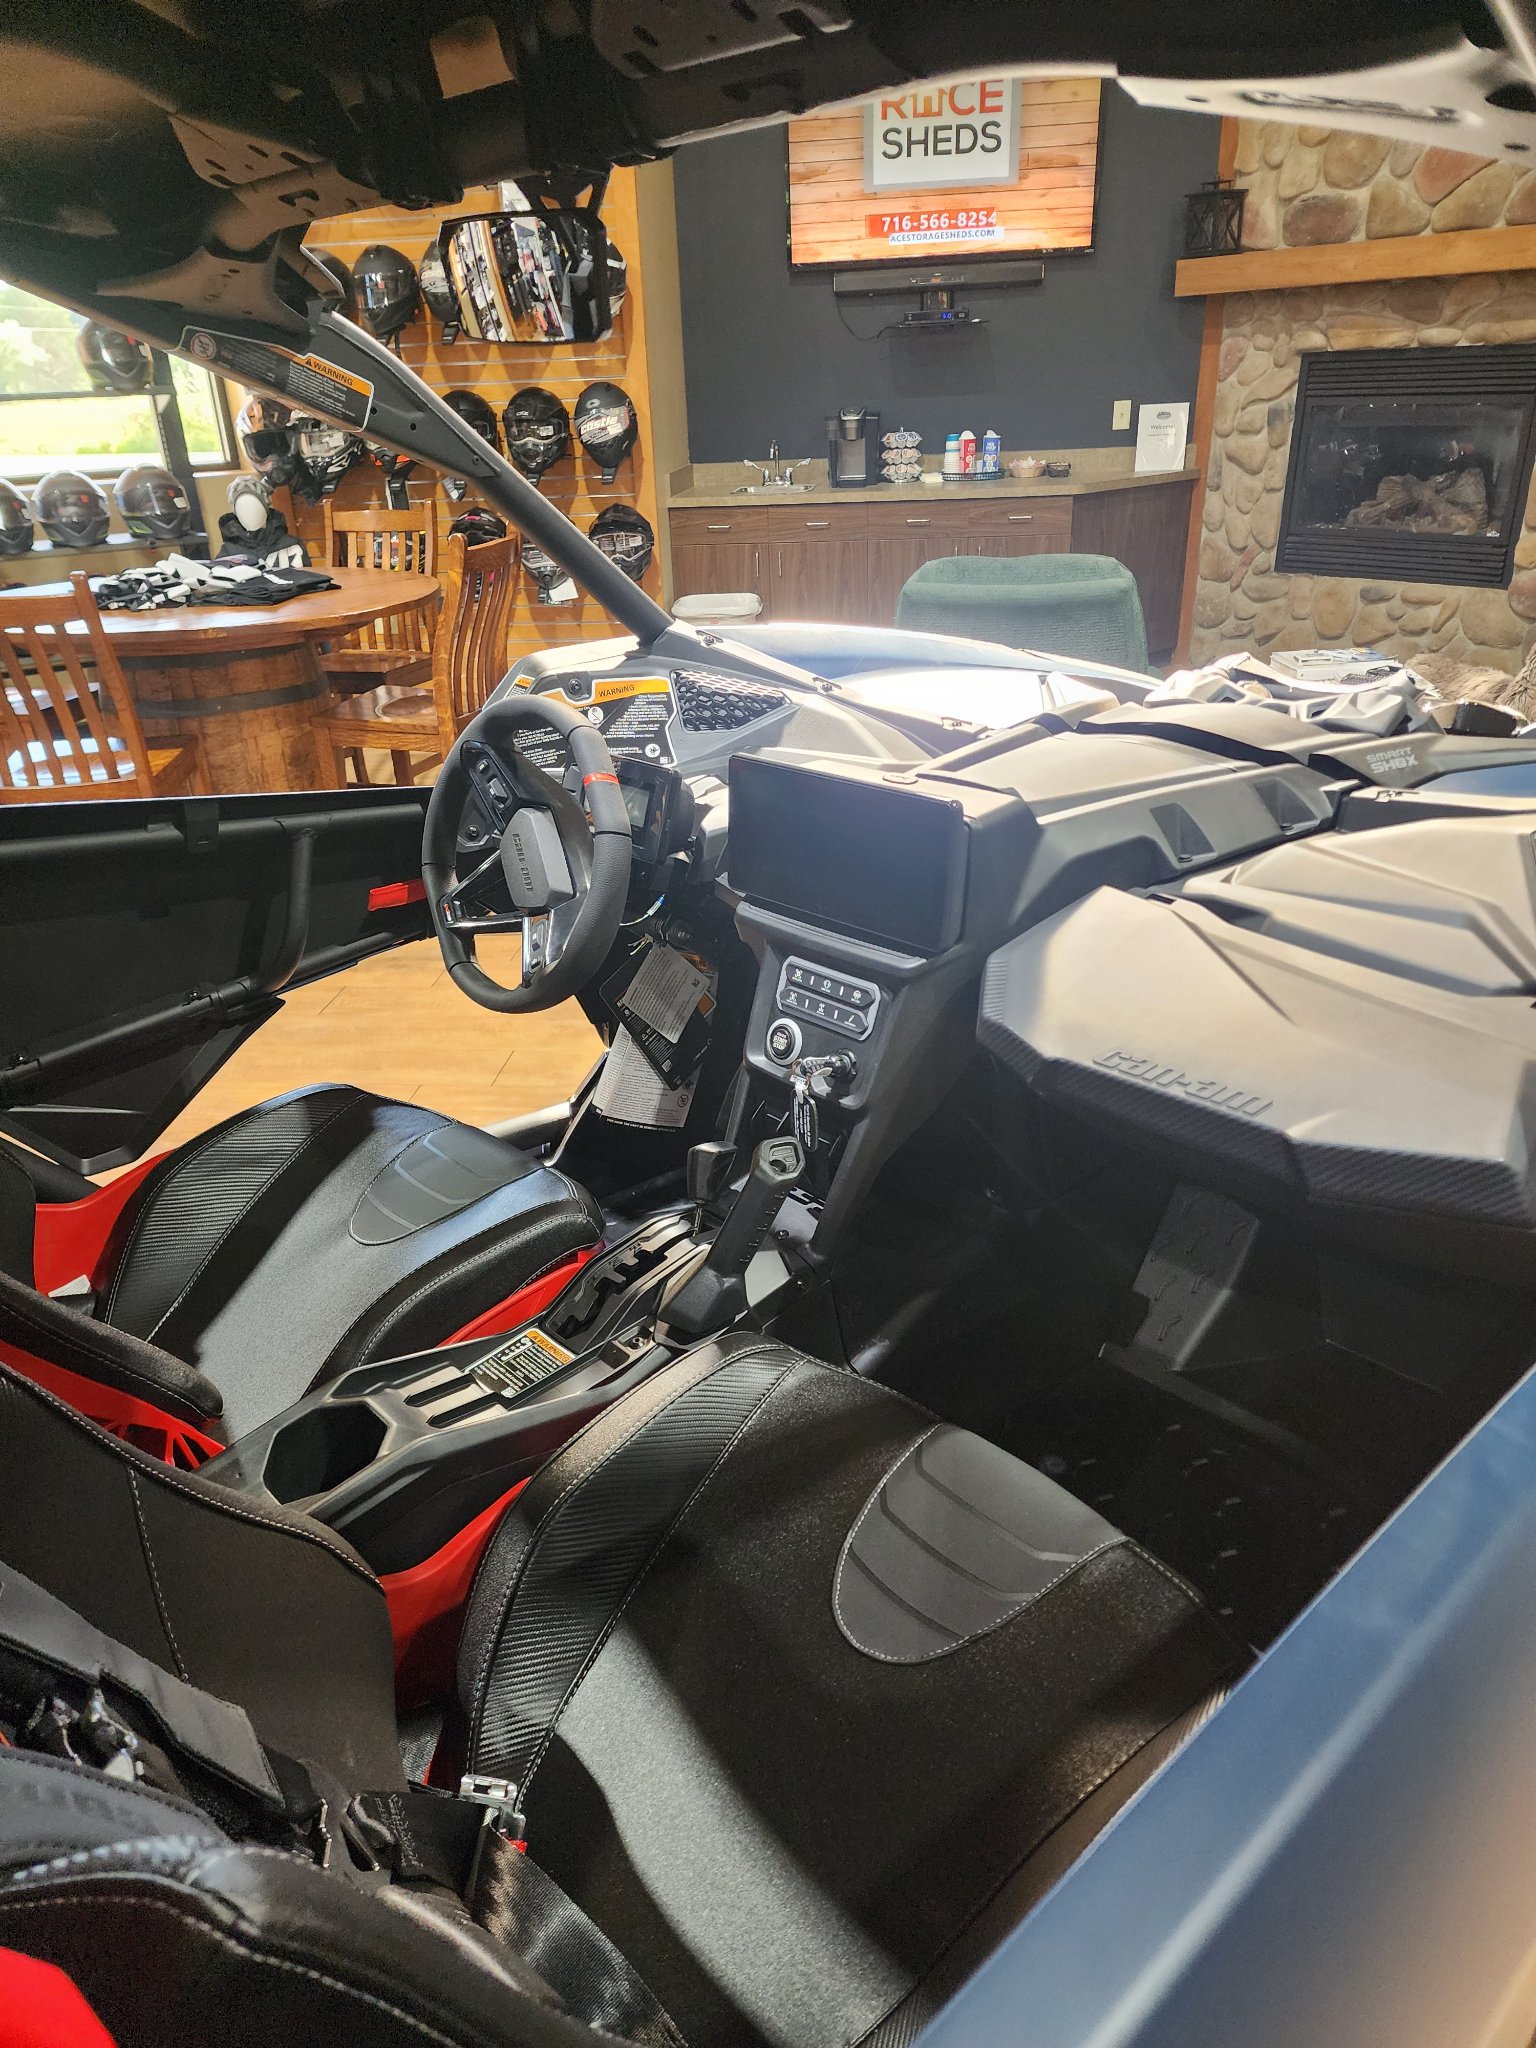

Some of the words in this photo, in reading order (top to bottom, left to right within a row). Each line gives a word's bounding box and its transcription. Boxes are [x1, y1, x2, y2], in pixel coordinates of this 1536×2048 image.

[882, 120, 1002, 160] SHEDS
[881, 210, 997, 233] 716-566-8254
[890, 228, 995, 243] ACESTORAGESHEDS.COM
[313, 360, 354, 386] WARNING
[598, 684, 635, 698] WARNING
[1366, 746, 1412, 763] SMART
[537, 1338, 570, 1363] WARNING
